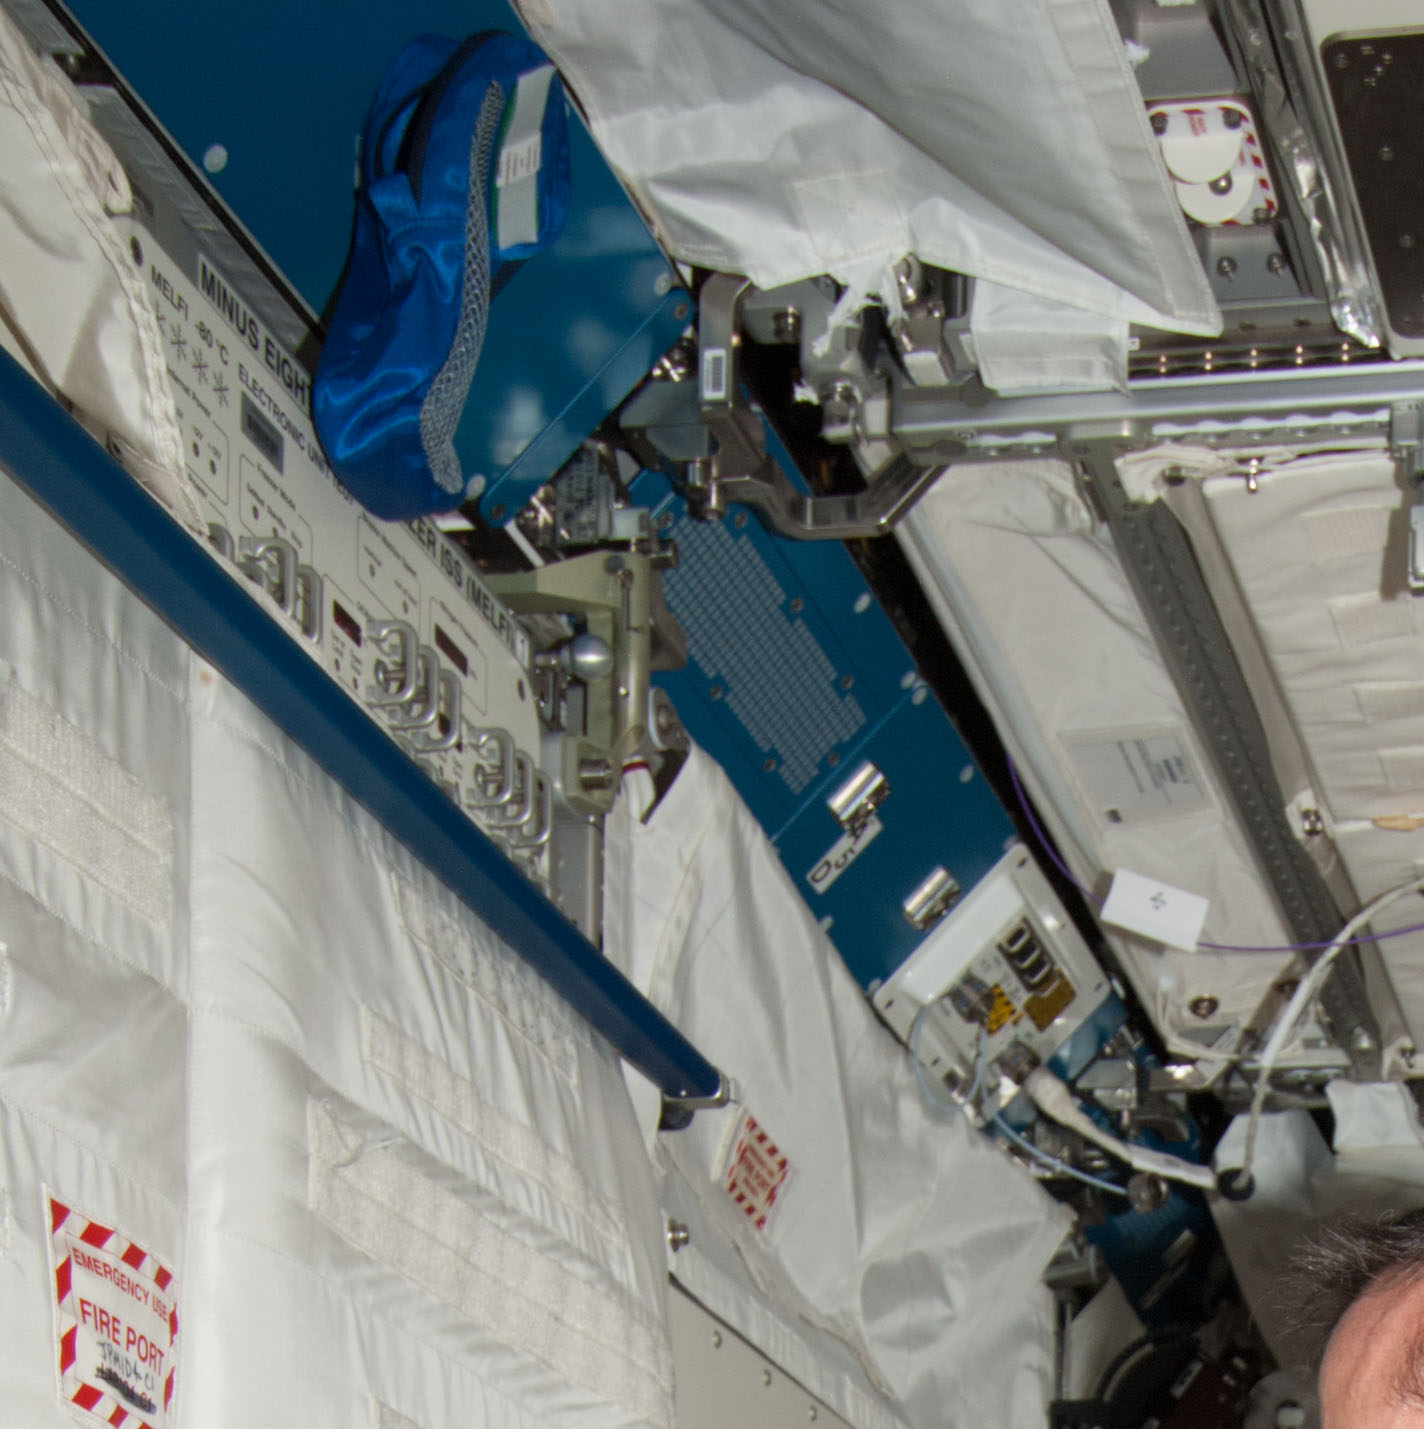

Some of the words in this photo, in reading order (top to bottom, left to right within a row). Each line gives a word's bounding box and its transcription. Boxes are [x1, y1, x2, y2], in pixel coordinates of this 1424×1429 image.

[151, 264, 190, 322] MELFI
[201, 261, 260, 351] MINUS
[264, 335, 313, 407] EIGH
[439, 542, 464, 589] ISS
[237, 362, 306, 452] ELECTRONIC
[72, 1246, 149, 1306] EMERGENCY
[152, 1296, 169, 1323] USE
[79, 1297, 121, 1346] FIRE
[126, 1325, 165, 1377] PORT
